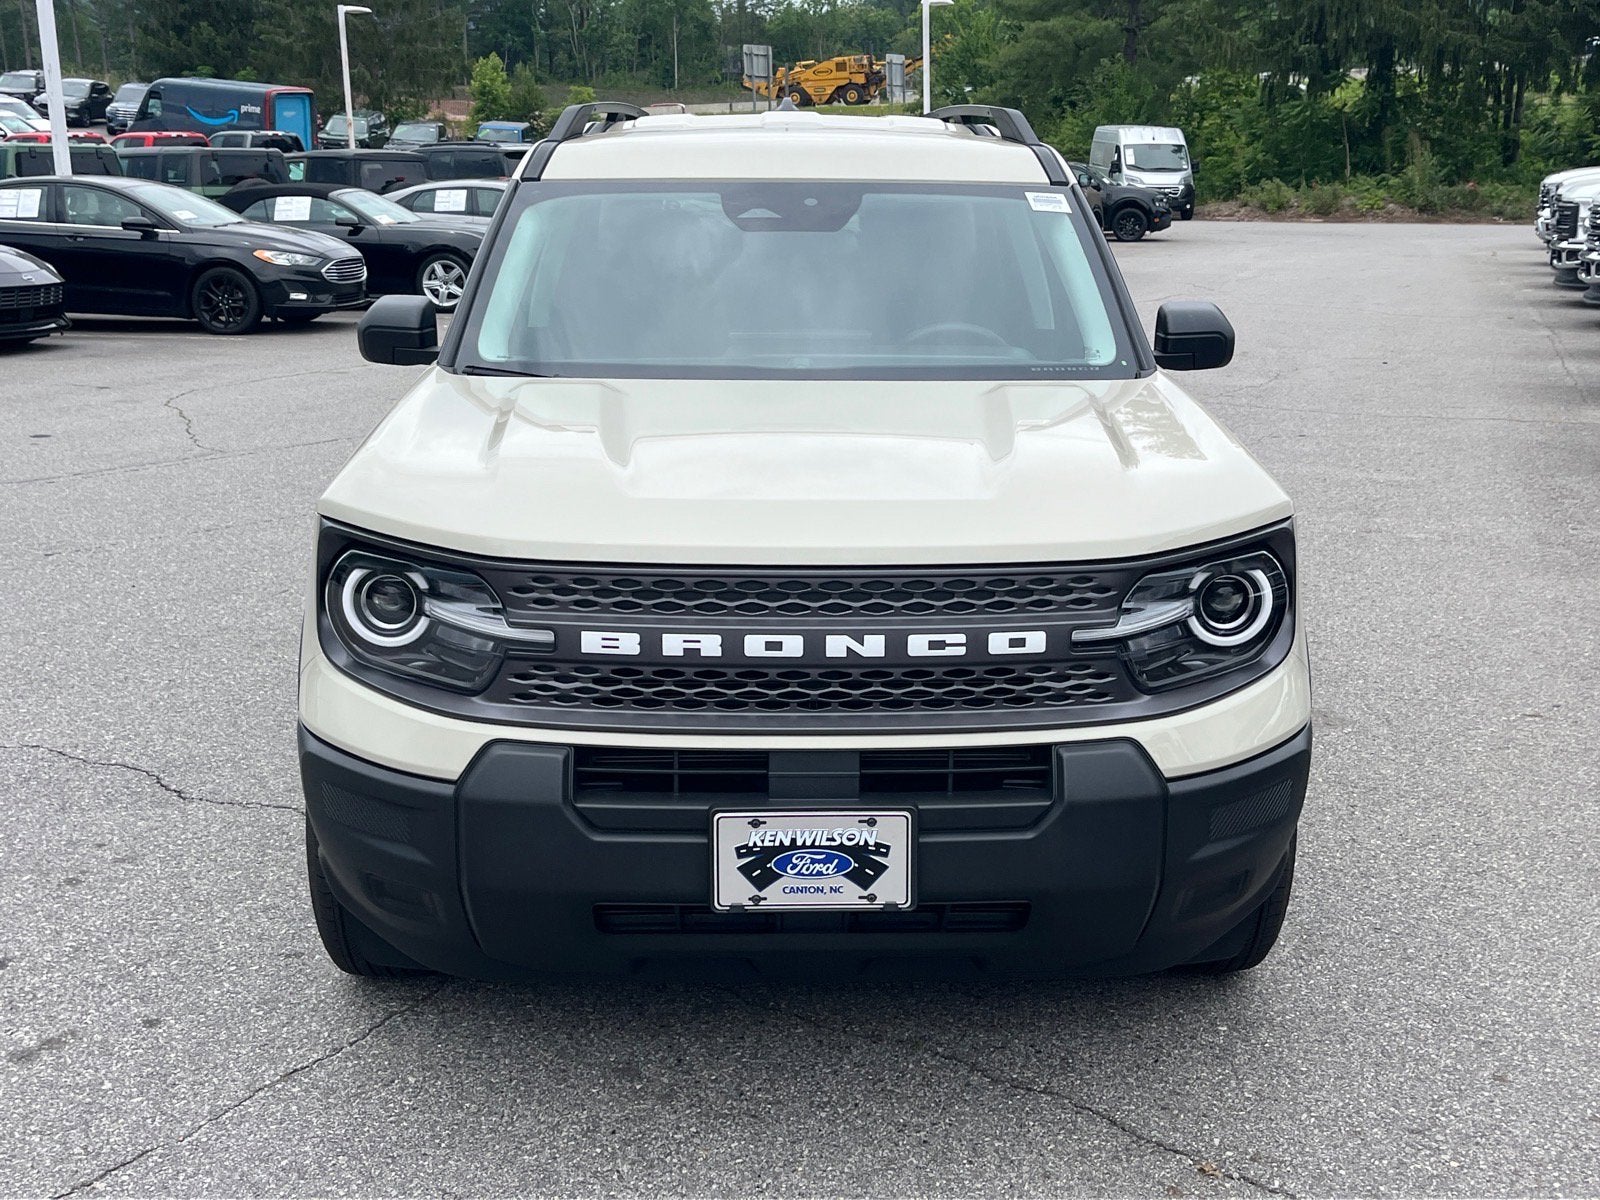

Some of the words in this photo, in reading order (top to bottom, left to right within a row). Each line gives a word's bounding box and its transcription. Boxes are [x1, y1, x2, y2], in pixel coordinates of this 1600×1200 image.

[241, 103, 261, 114] prime
[580, 630, 1046, 657] BRONCO
[786, 853, 839, 875] Ford
[782, 886, 827, 895] CANTON,
[829, 885, 844, 894] NC
